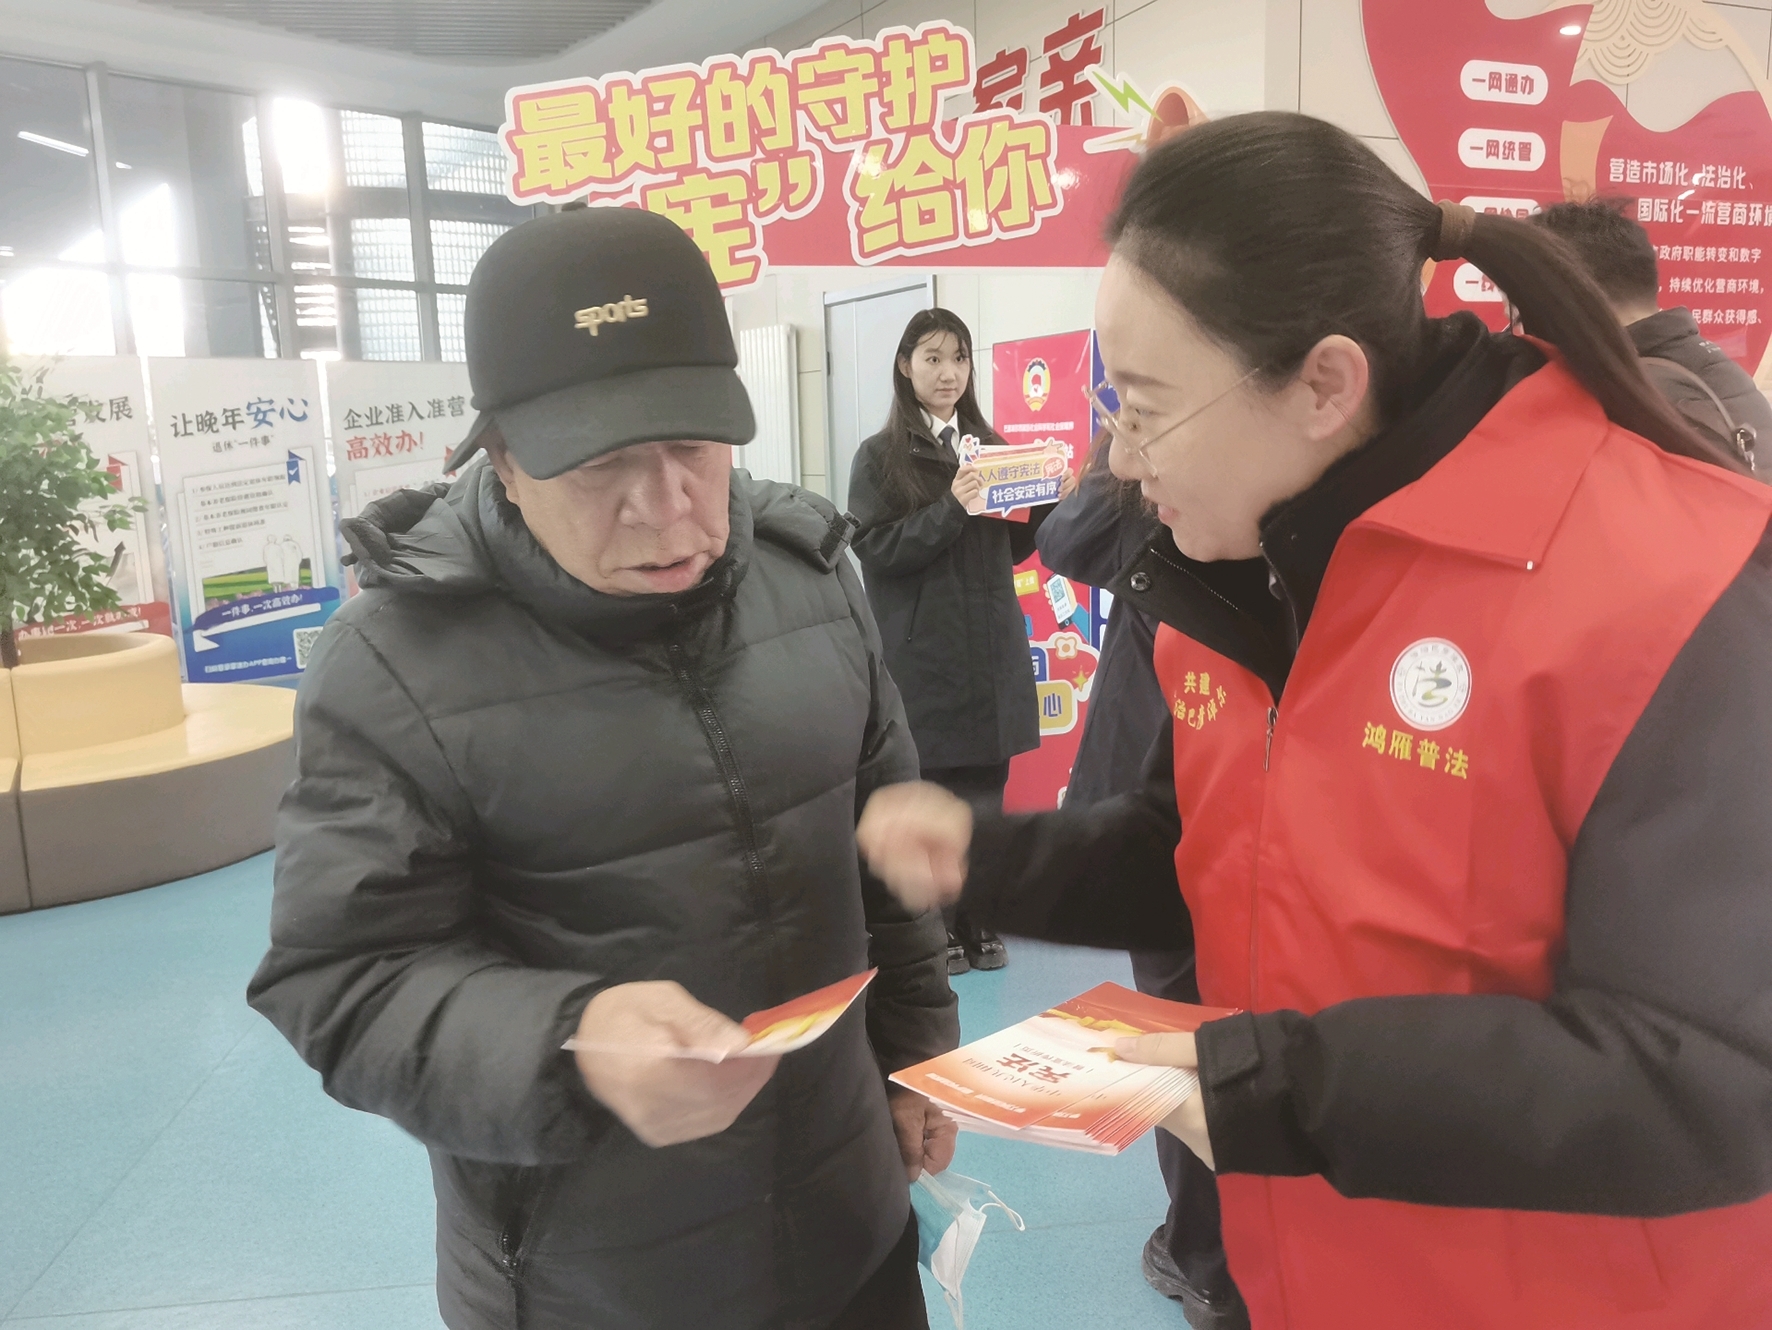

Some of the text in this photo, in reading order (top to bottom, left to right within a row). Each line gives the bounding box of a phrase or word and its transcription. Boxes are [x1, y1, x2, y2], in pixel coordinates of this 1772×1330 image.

[1471, 71, 1535, 96] 一网通办
[512, 30, 970, 195] 最好的守护
[1469, 139, 1532, 162] 一网统管
[1653, 244, 1762, 264] 政府职能转变和数字
[170, 396, 309, 438] 让晚年安心
[343, 394, 466, 431] 企业准入准营
[991, 481, 1058, 504] 社会安定有序
[1362, 721, 1470, 780] 鸿雁普法
[996, 1052, 1073, 1084] 宪法
